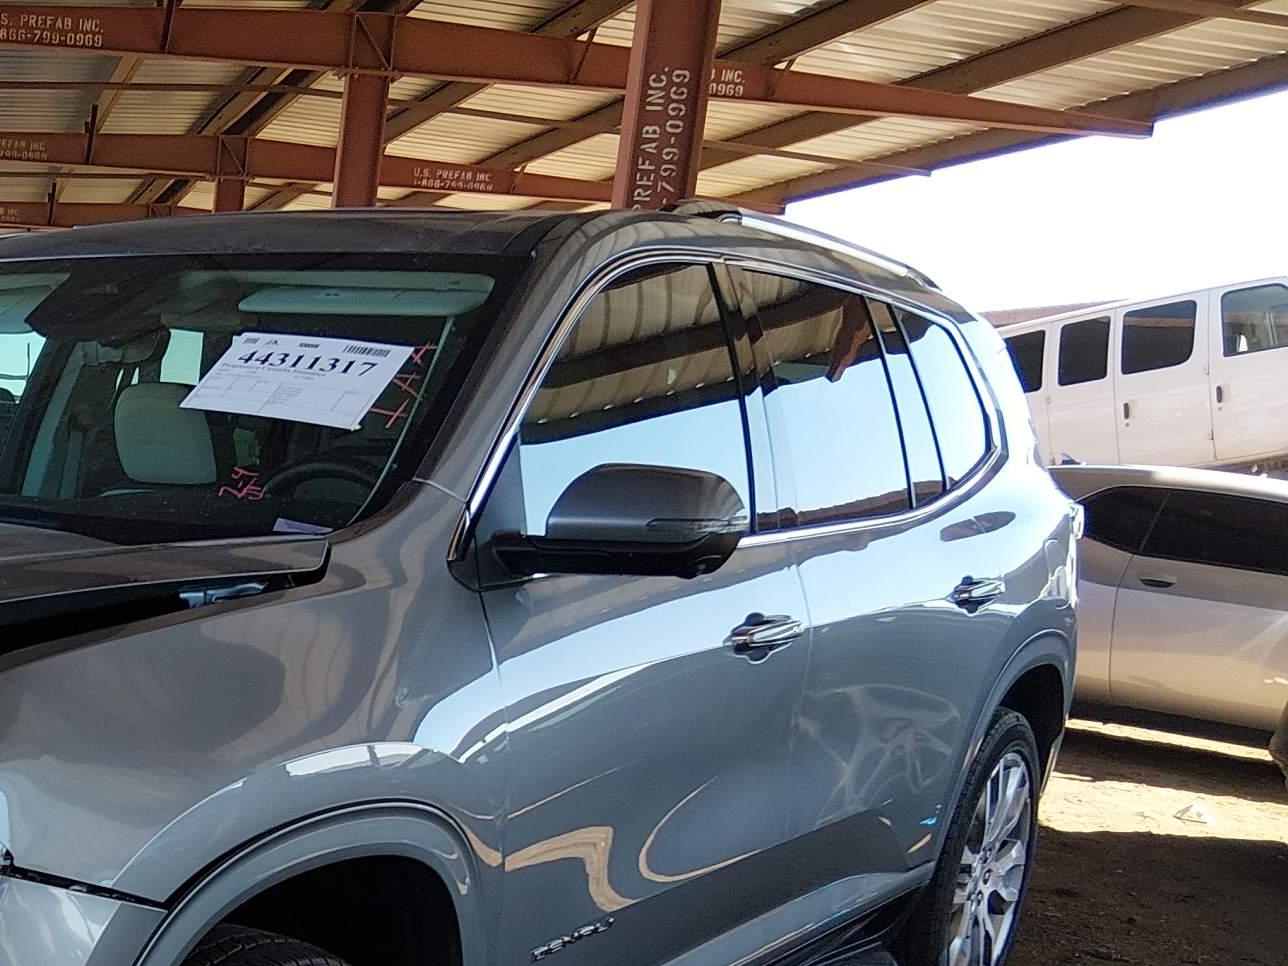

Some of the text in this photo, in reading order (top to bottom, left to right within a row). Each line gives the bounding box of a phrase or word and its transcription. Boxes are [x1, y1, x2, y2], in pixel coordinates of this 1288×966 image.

[20, 14, 72, 30] PREFAB
[79, 18, 104, 33] INC.
[721, 69, 746, 84] INC.
[645, 66, 669, 111] INC.
[436, 168, 473, 182] PREFAB
[238, 349, 378, 377] 44311317
